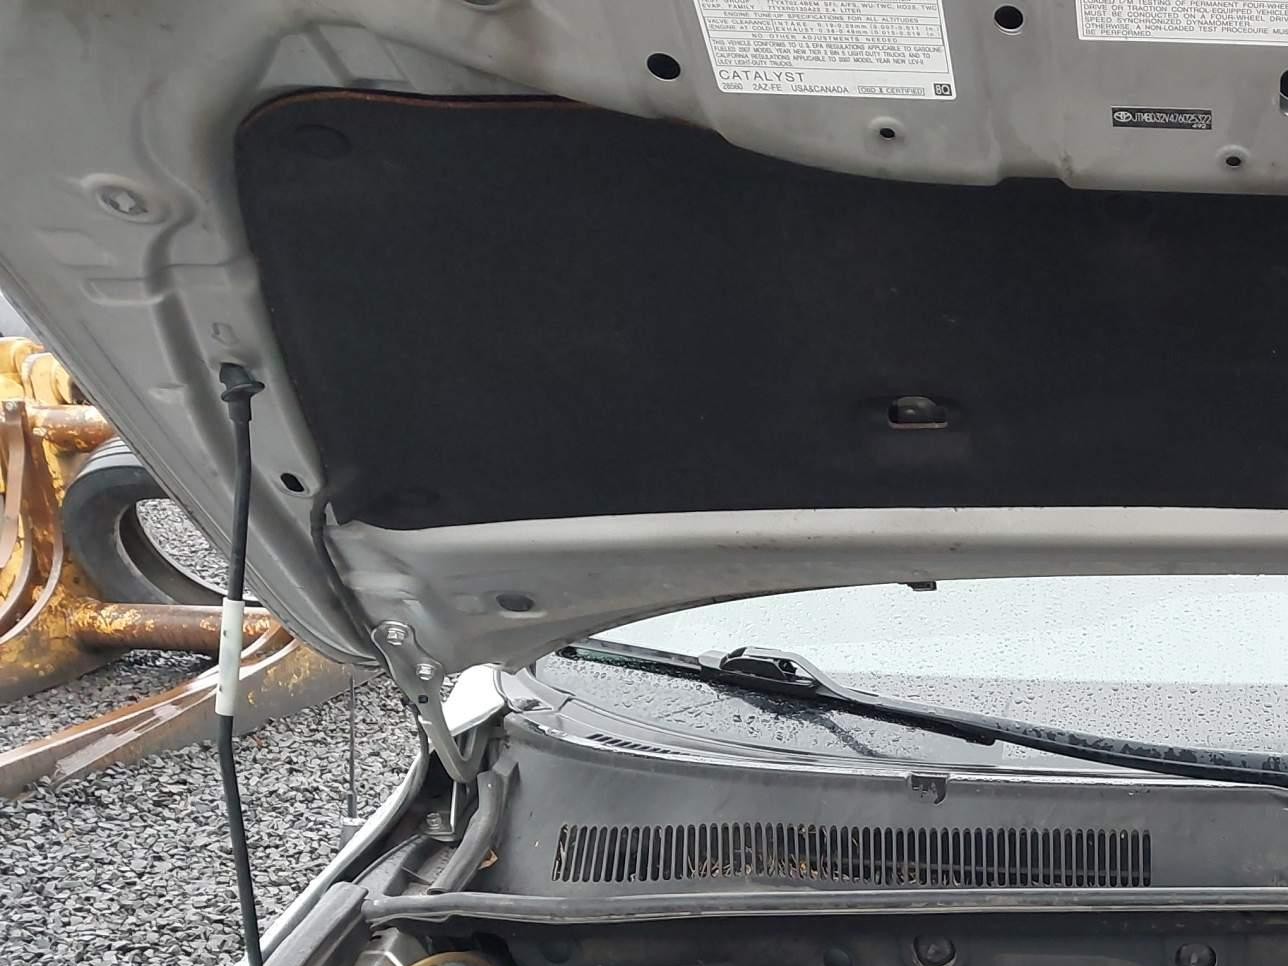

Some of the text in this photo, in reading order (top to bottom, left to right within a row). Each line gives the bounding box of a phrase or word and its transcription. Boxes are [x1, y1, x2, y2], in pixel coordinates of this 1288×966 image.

[1170, 6, 1250, 14] CONTROL-EQUIPPED
[1116, 16, 1182, 25] SYNCHRONIZED
[719, 68, 804, 82] CATALYST
[752, 83, 782, 92] 2AZ-FE
[790, 84, 849, 94] USA&CANADA
